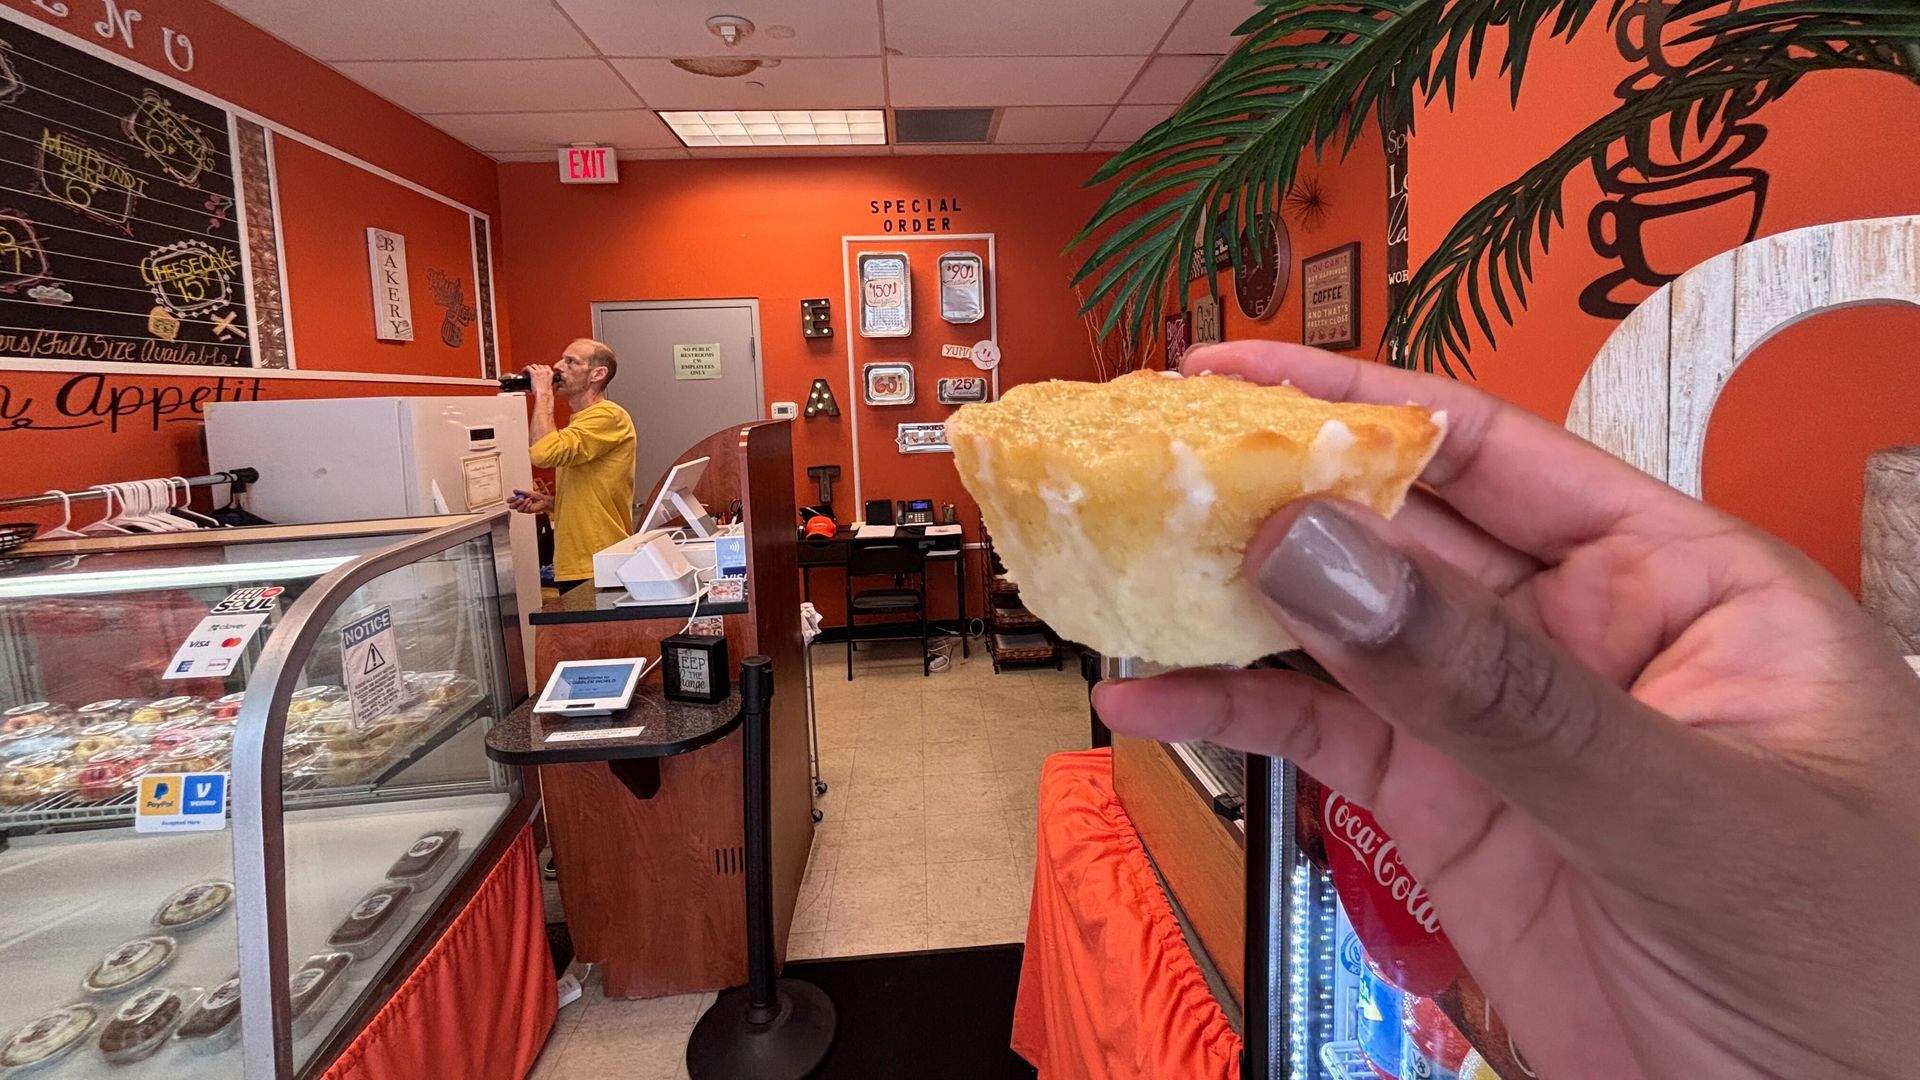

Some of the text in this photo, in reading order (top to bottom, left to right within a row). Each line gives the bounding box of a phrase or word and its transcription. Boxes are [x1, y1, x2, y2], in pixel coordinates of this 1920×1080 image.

[568, 149, 606, 179] EXIT
[870, 198, 962, 214] SPECIAL
[884, 218, 951, 232] ORDER
[141, 247, 240, 287] CHEESECAKE
[384, 237, 405, 335] BAKERY
[1313, 285, 1342, 304] COFFEE
[1308, 303, 1348, 319] AND THAT'S
[1329, 314, 1348, 325] CLOSE
[88, 335, 137, 362] Size
[56, 373, 266, 433] Appetit
[213, 598, 274, 612] SOUL
[218, 623, 247, 631] clover
[344, 611, 391, 646] NOTICE
[189, 640, 211, 648] VISA
[679, 656, 705, 670] EEP
[146, 801, 175, 809] PayPal
